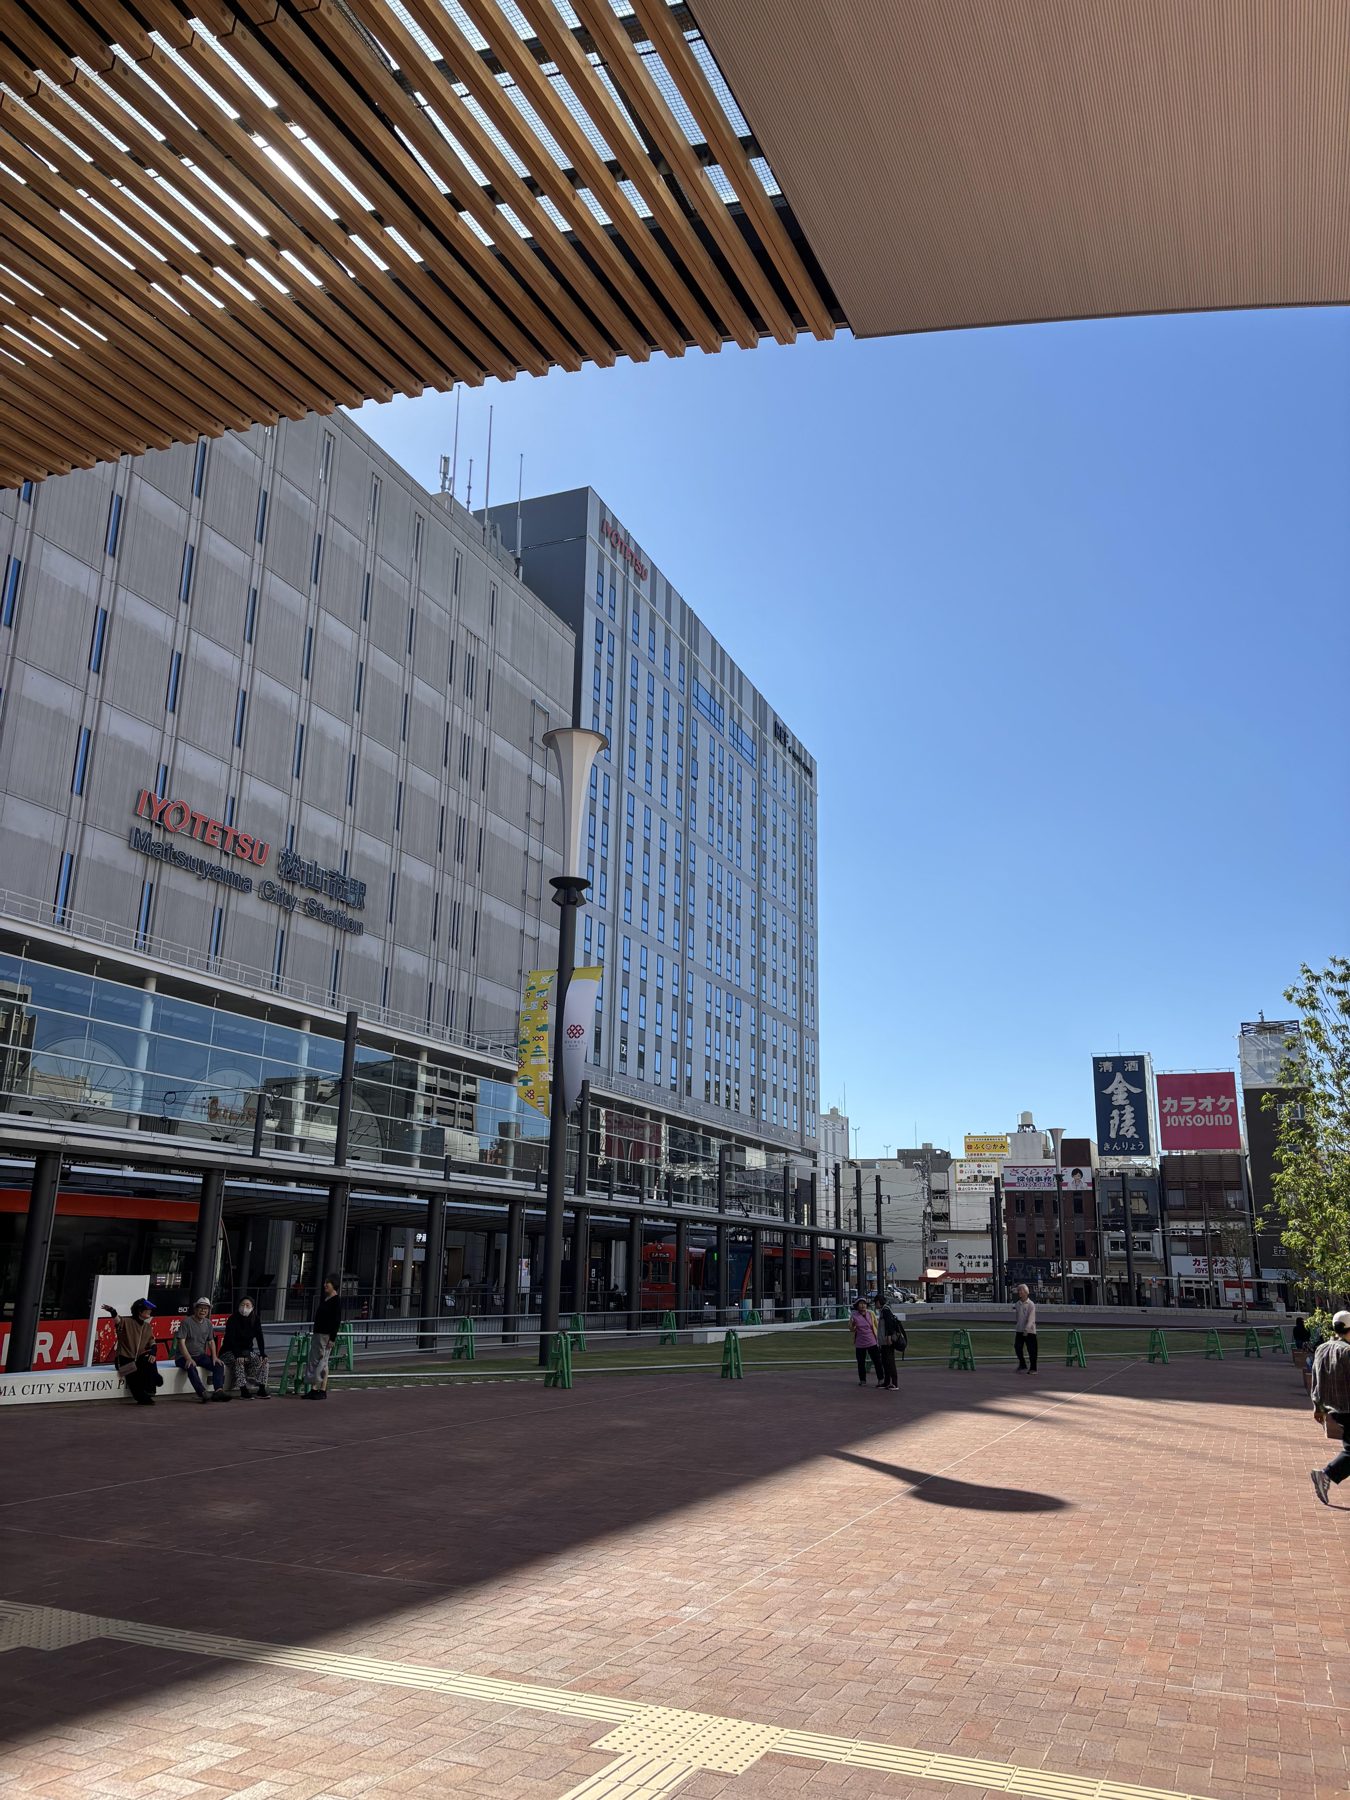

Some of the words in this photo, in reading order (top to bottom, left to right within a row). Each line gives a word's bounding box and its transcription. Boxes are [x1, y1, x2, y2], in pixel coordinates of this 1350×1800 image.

[134, 788, 271, 867] IYOTETSU
[130, 826, 253, 893] Matsuyama
[259, 879, 298, 913] City
[304, 897, 364, 936] Station
[278, 848, 367, 911] 松山市駅
[1098, 1060, 1139, 1073] 清酒
[1101, 1072, 1143, 1139] 金陵
[1161, 1095, 1235, 1114] カラオケ
[1165, 1114, 1233, 1127] JOYSOUND
[1103, 1141, 1144, 1151] きんりょう
[1194, 1267, 1229, 1275] JOYSUND
[21, 1382, 55, 1396] CITY
[58, 1379, 114, 1393] STATION
